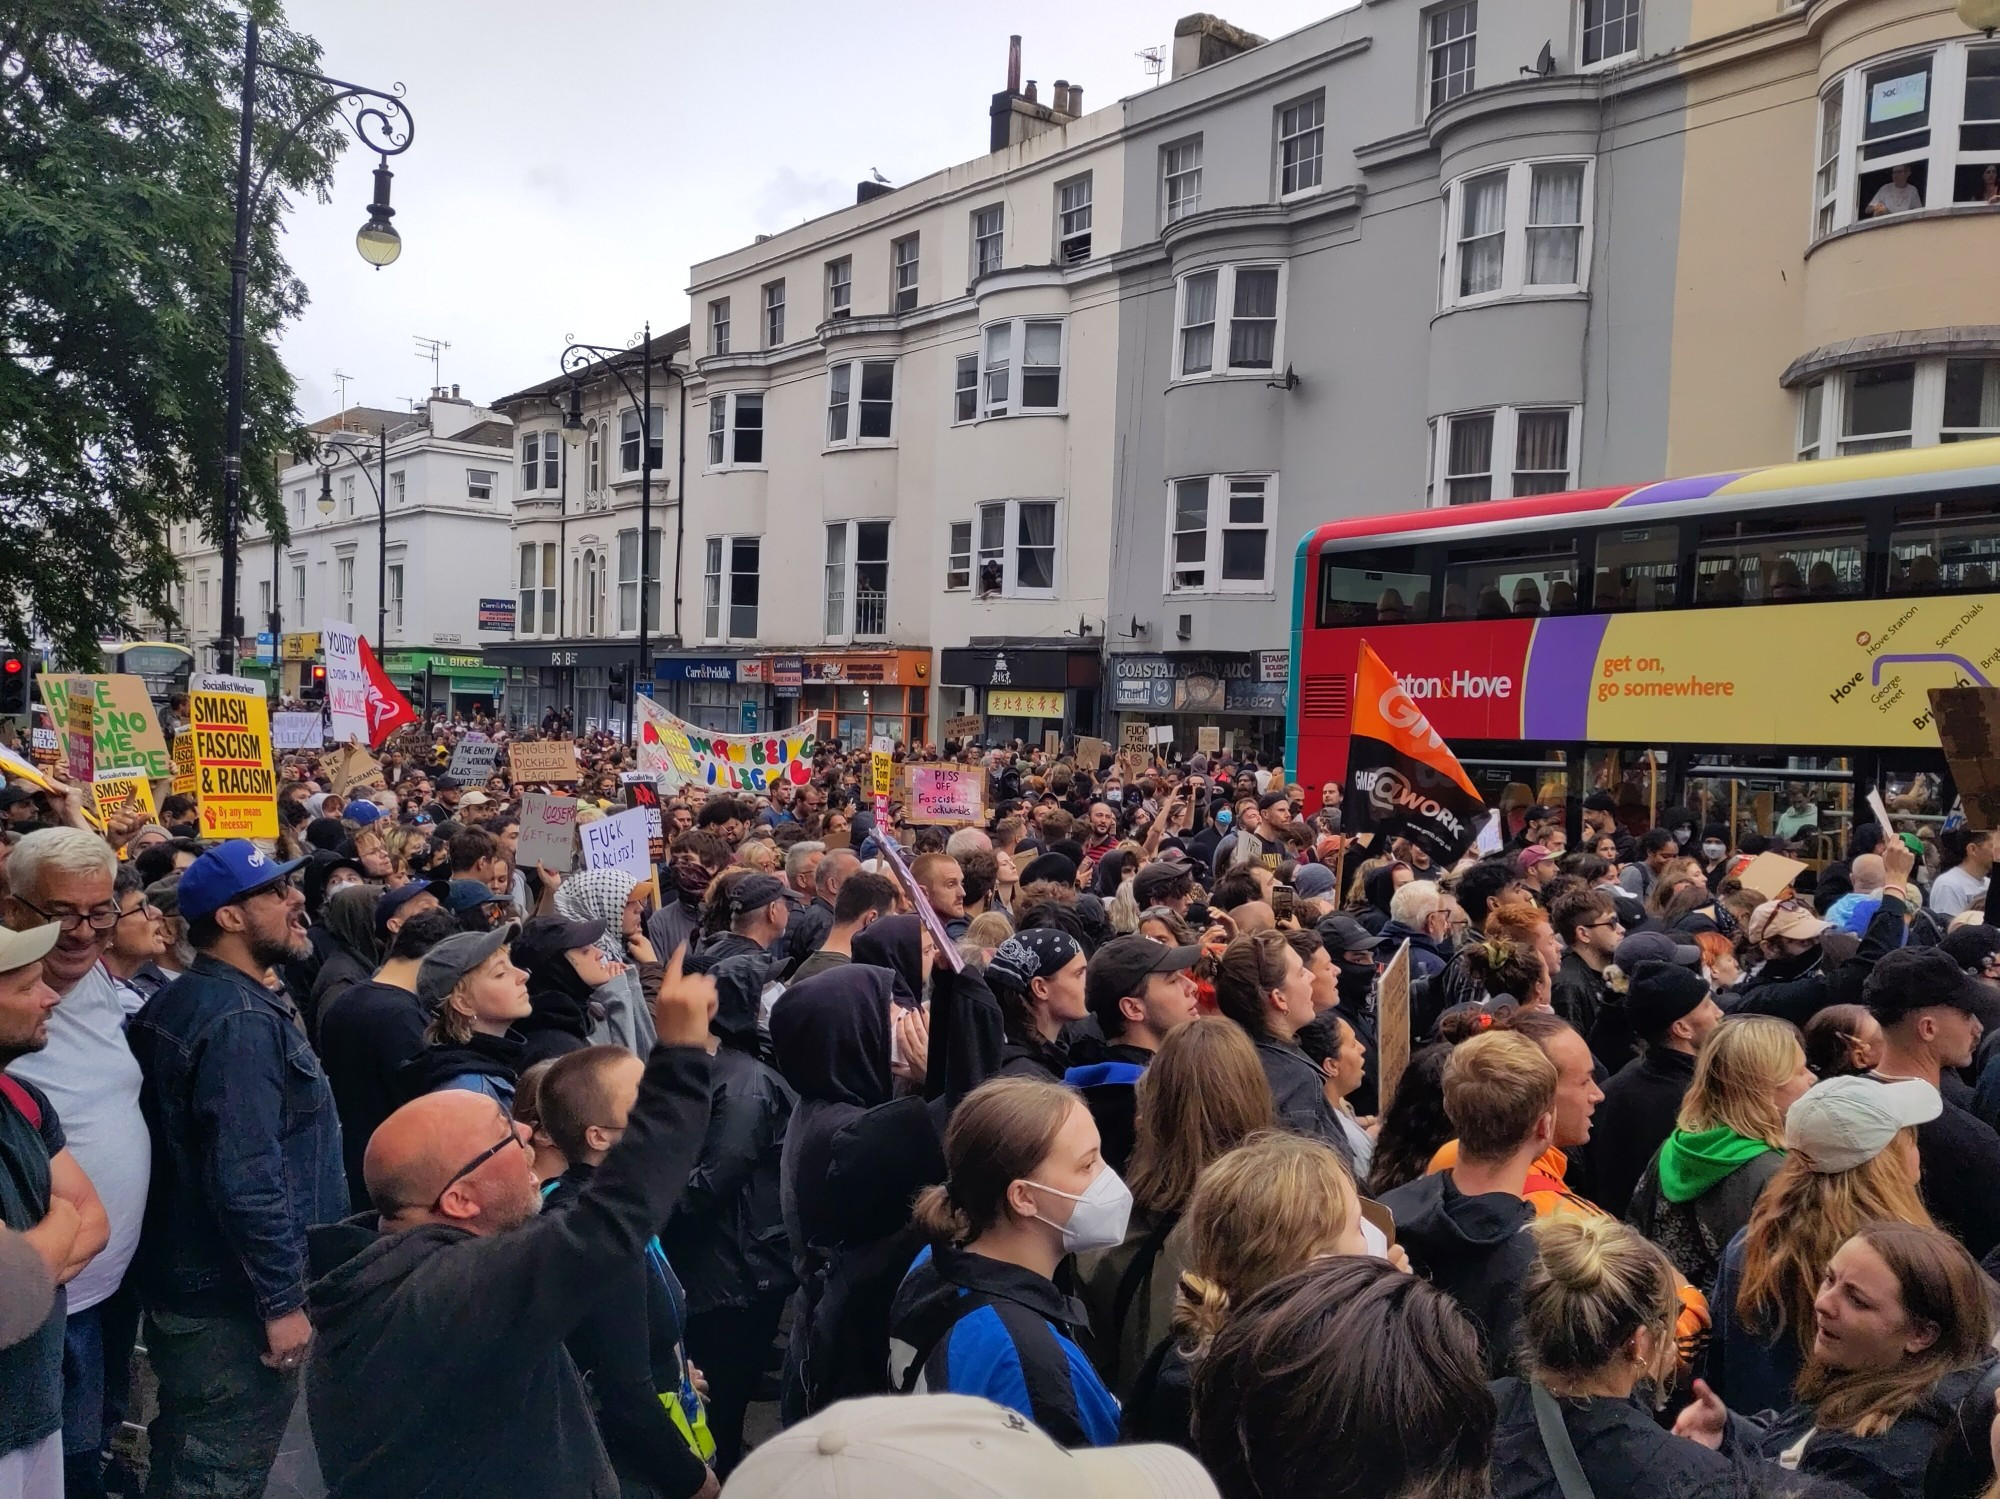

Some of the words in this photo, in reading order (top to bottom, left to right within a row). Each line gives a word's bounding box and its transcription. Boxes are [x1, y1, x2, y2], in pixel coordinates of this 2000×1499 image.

[1866, 634, 1890, 656] Hove
[1888, 605, 1919, 636] Station
[1936, 624, 1962, 649] Seven
[1960, 603, 1985, 625] Dials
[449, 658, 480, 668] BIKES
[1117, 662, 1177, 679] COASTAL
[1603, 655, 1632, 678] get
[1636, 658, 1665, 675] on,
[1156, 681, 1169, 704] 2
[1597, 682, 1619, 702] go
[1624, 675, 1735, 696] somewhere
[1830, 672, 1864, 704] Hove
[1871, 675, 1901, 704] George
[195, 696, 248, 724] SMASH
[992, 696, 1060, 714] 老北京家常菜
[1879, 688, 1905, 714] Street
[108, 711, 147, 733] NO
[1126, 725, 1148, 735] FUCK
[197, 732, 261, 759] FASCISM
[461, 746, 472, 754] THE
[474, 746, 495, 755] ENEMY
[513, 743, 568, 755] ENGLISH
[751, 733, 816, 765] BEING
[324, 755, 340, 767] WE
[514, 758, 566, 769] DICKHEAD
[202, 767, 214, 793] &
[217, 768, 273, 794] RACISM
[451, 768, 472, 776] CLASS
[935, 771, 960, 781] PISS
[95, 780, 134, 798] SMASH
[918, 793, 955, 804] Fascist
[219, 806, 226, 819] By
[230, 808, 241, 819] any
[244, 808, 262, 816] means
[221, 820, 253, 831] necessary
[523, 826, 543, 841] GET
[589, 820, 624, 850] FUCK
[592, 839, 635, 869] RACISTS!
